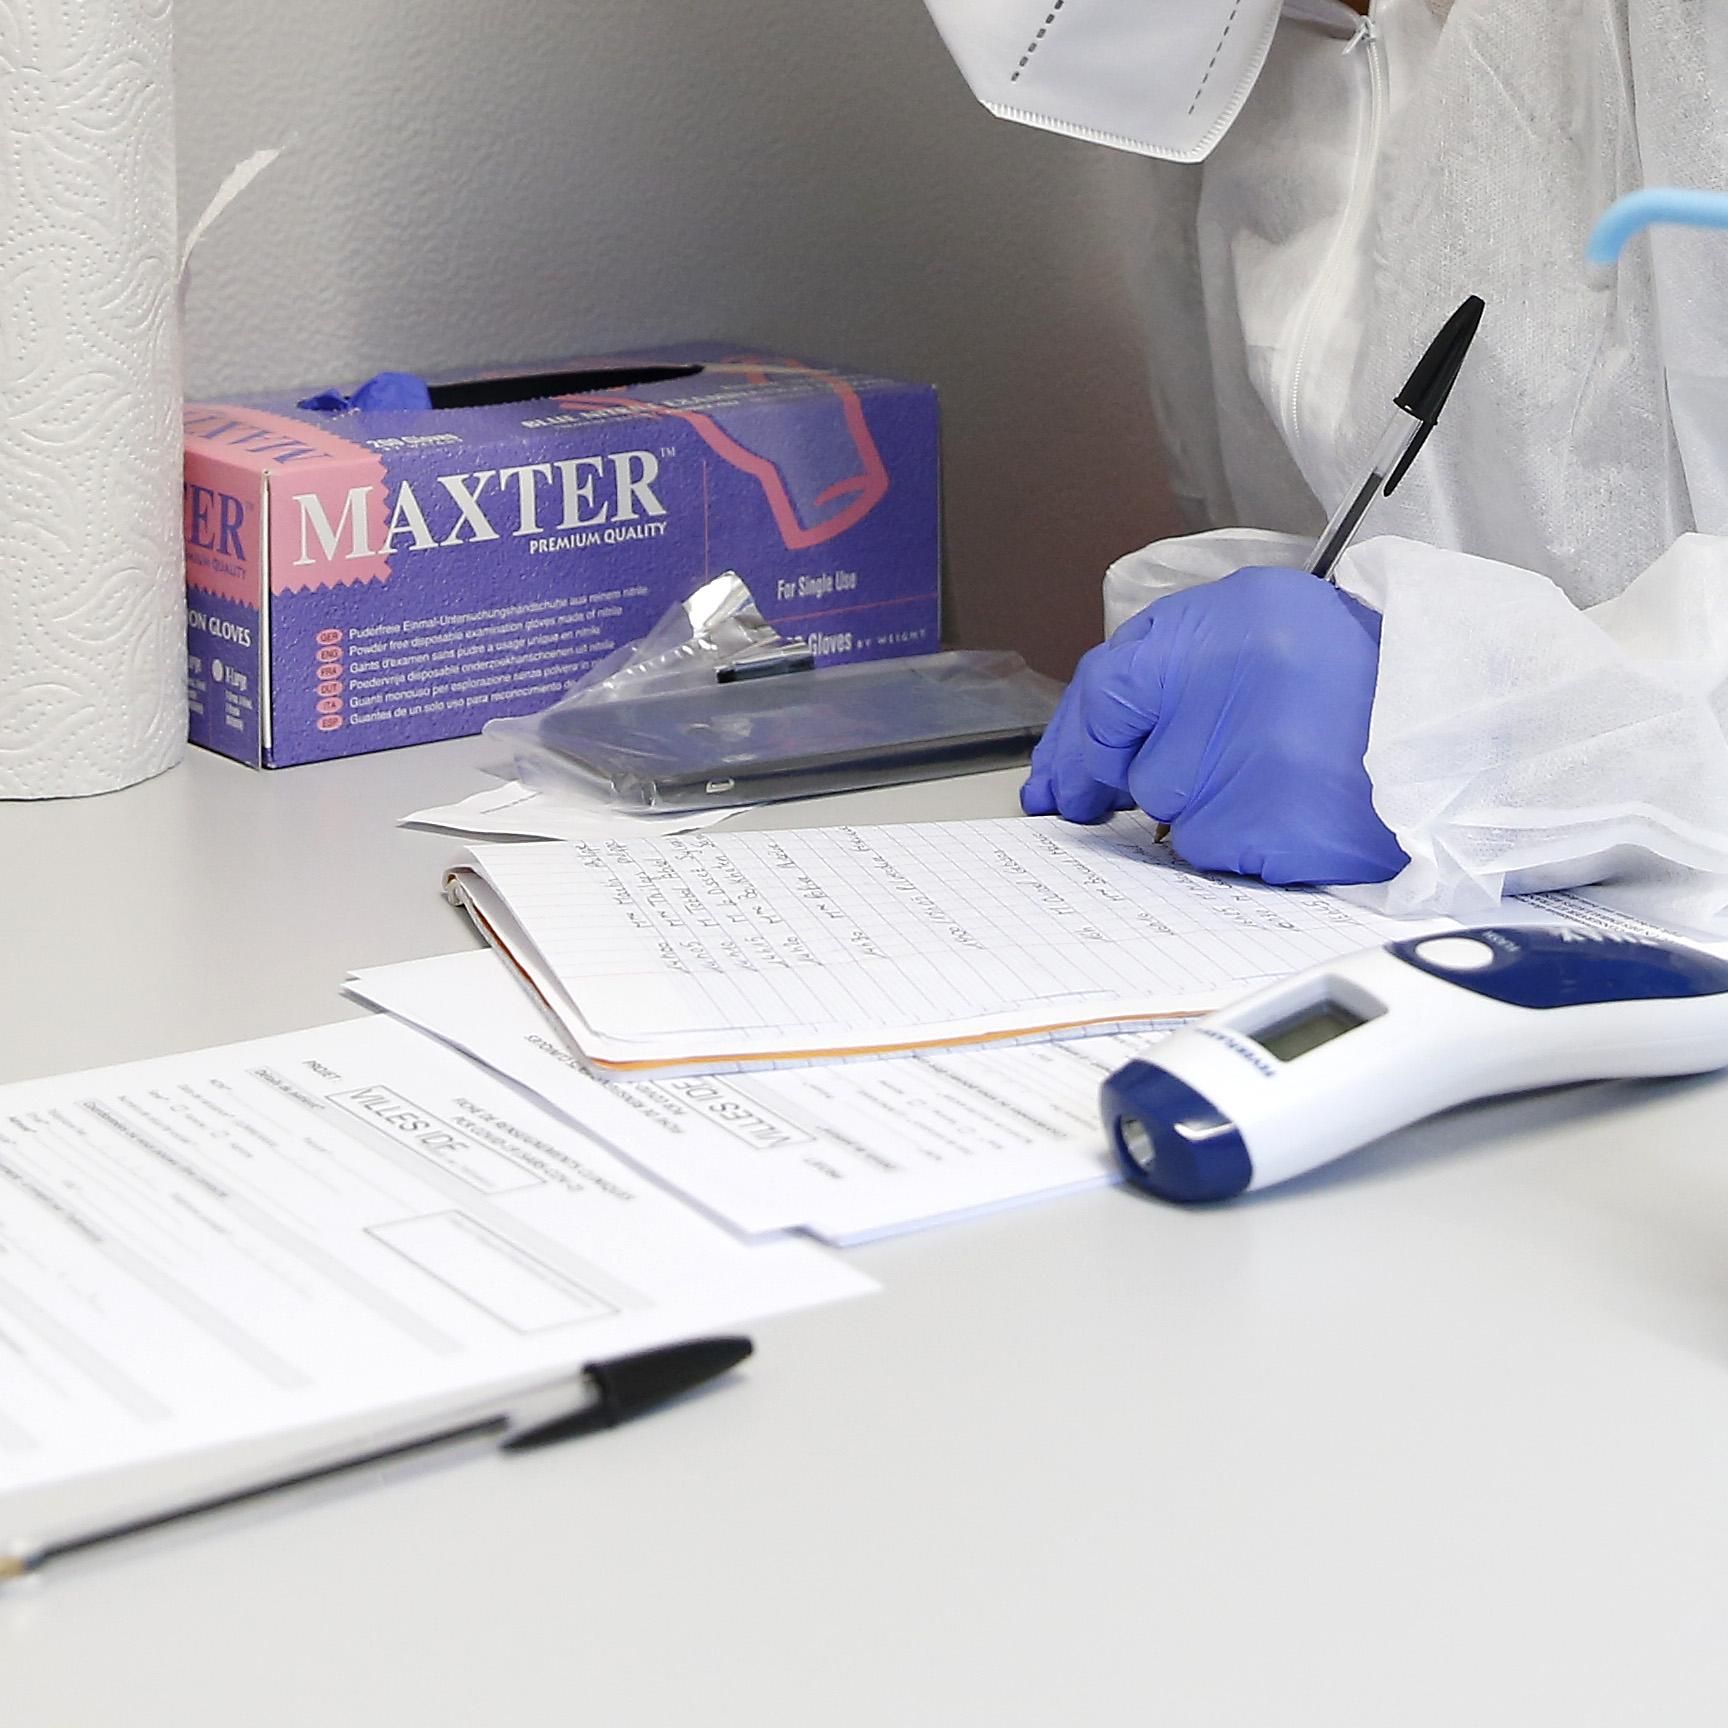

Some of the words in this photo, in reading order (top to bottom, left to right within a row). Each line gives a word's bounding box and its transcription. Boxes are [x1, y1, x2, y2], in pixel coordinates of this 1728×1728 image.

[292, 450, 669, 567] MAXTER
[529, 530, 599, 556] PREMIUM
[603, 521, 668, 546] QUALITY
[777, 579, 795, 600] For
[798, 574, 833, 599] Single
[835, 571, 857, 591] Use
[208, 616, 252, 648] GLOVES
[321, 632, 339, 642] GER
[349, 623, 401, 640] Puderfreie
[349, 641, 388, 656] Powder
[389, 638, 409, 650] free
[410, 630, 464, 649] disposable
[464, 621, 523, 638] examination
[524, 616, 556, 631] gloves
[557, 612, 586, 624] made
[586, 608, 596, 620] of
[808, 632, 853, 656] Gloves
[321, 649, 339, 659] ENG
[350, 659, 381, 674] Gants
[382, 653, 430, 669] d'examen
[431, 649, 455, 661] sans
[496, 638, 526, 653] usage
[321, 684, 339, 694] DUT
[350, 692, 384, 708] Guanti
[385, 687, 431, 703] monouso
[321, 718, 339, 728] ESP
[350, 708, 393, 725] Guantes
[393, 705, 408, 718] de
[409, 702, 422, 715] un
[423, 699, 445, 712] solo
[446, 696, 465, 710] uso
[466, 693, 489, 708] para
[348, 1087, 423, 1134] VILLES
[418, 1129, 470, 1153] IDF
[709, 1102, 791, 1145] VILLES
